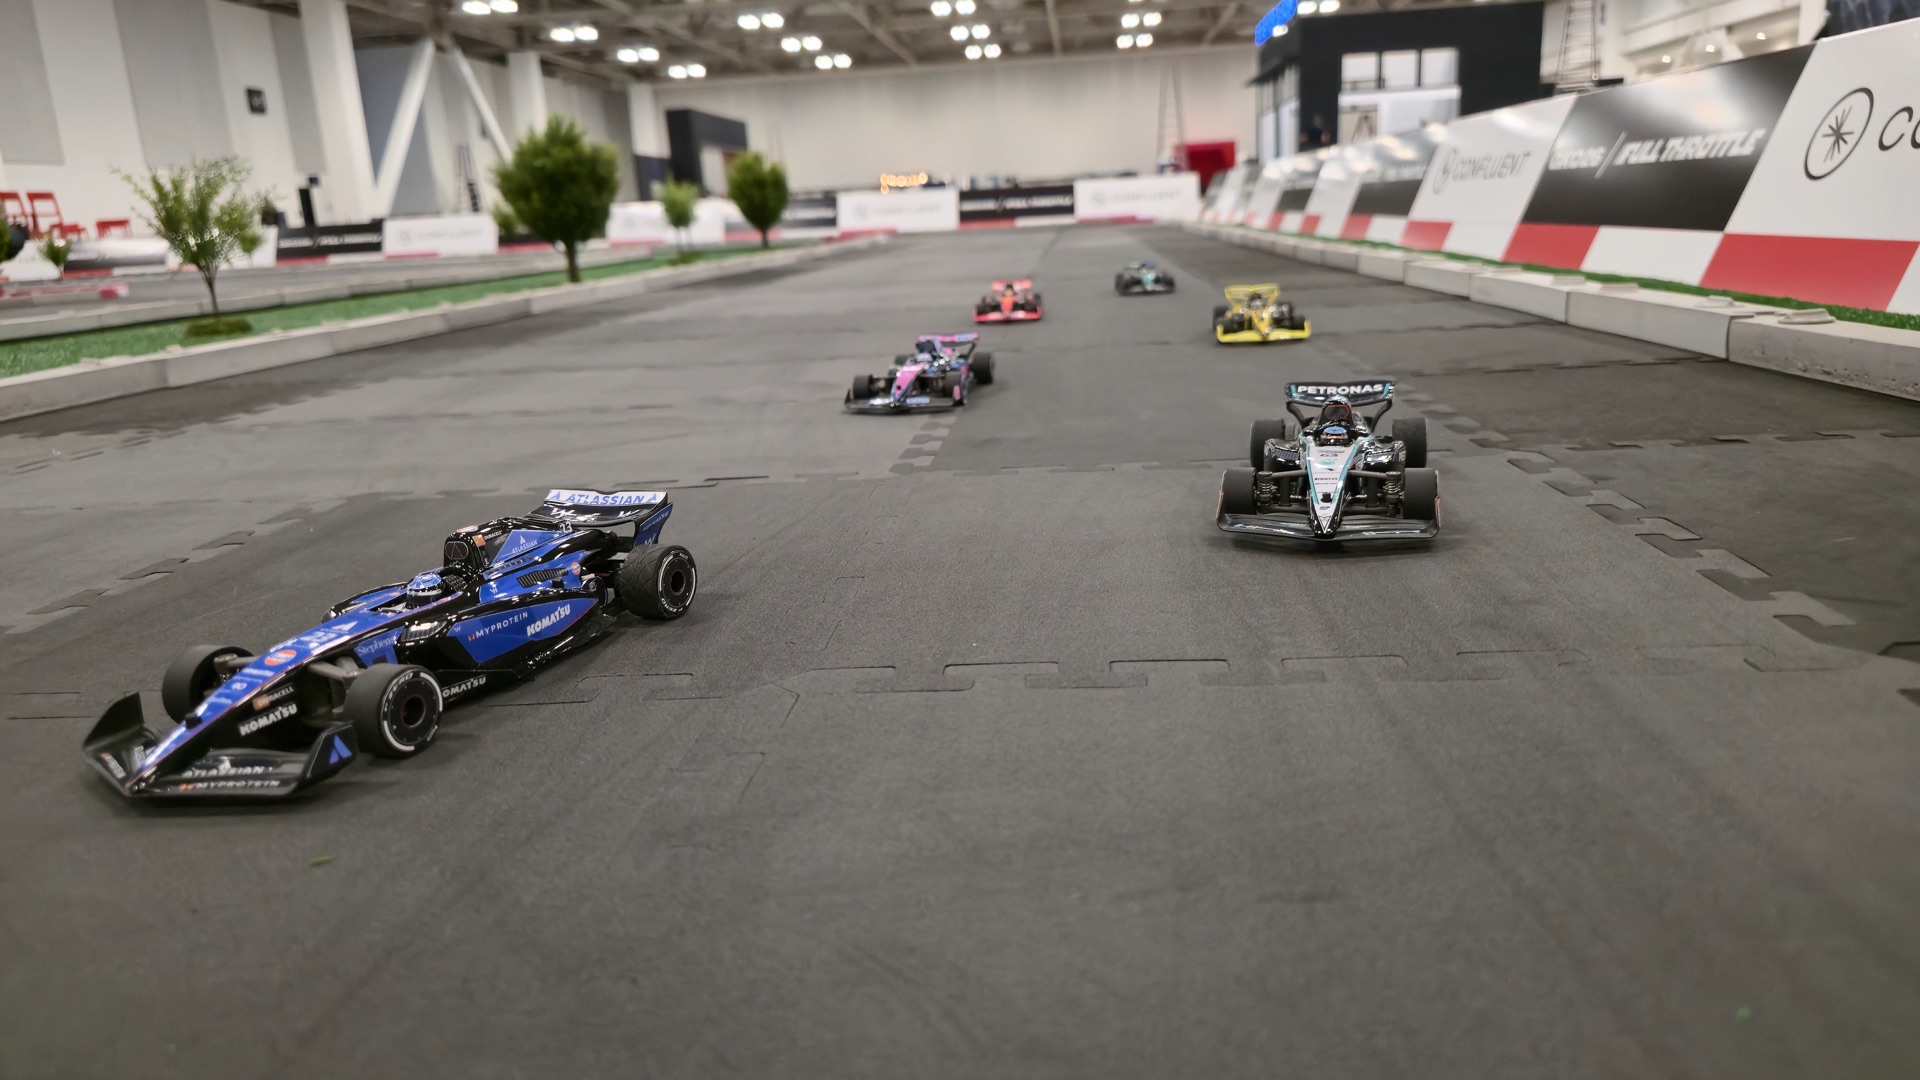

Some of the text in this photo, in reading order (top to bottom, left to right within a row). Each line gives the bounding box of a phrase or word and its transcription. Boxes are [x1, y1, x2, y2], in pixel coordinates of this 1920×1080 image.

[1612, 138, 1665, 165] FULL
[1659, 128, 1767, 162] THROTTLE
[1452, 151, 1531, 180] CONFLUENT
[1297, 384, 1384, 395] PETRONAS
[566, 493, 645, 505] ATLASSIAN
[559, 521, 573, 533] 23
[512, 540, 538, 554] ATLASSIAN
[475, 611, 528, 638] MYPROTEIN
[526, 603, 571, 637] KOMATSU
[442, 676, 487, 697] OMATSU
[240, 703, 298, 735] KOMATSU
